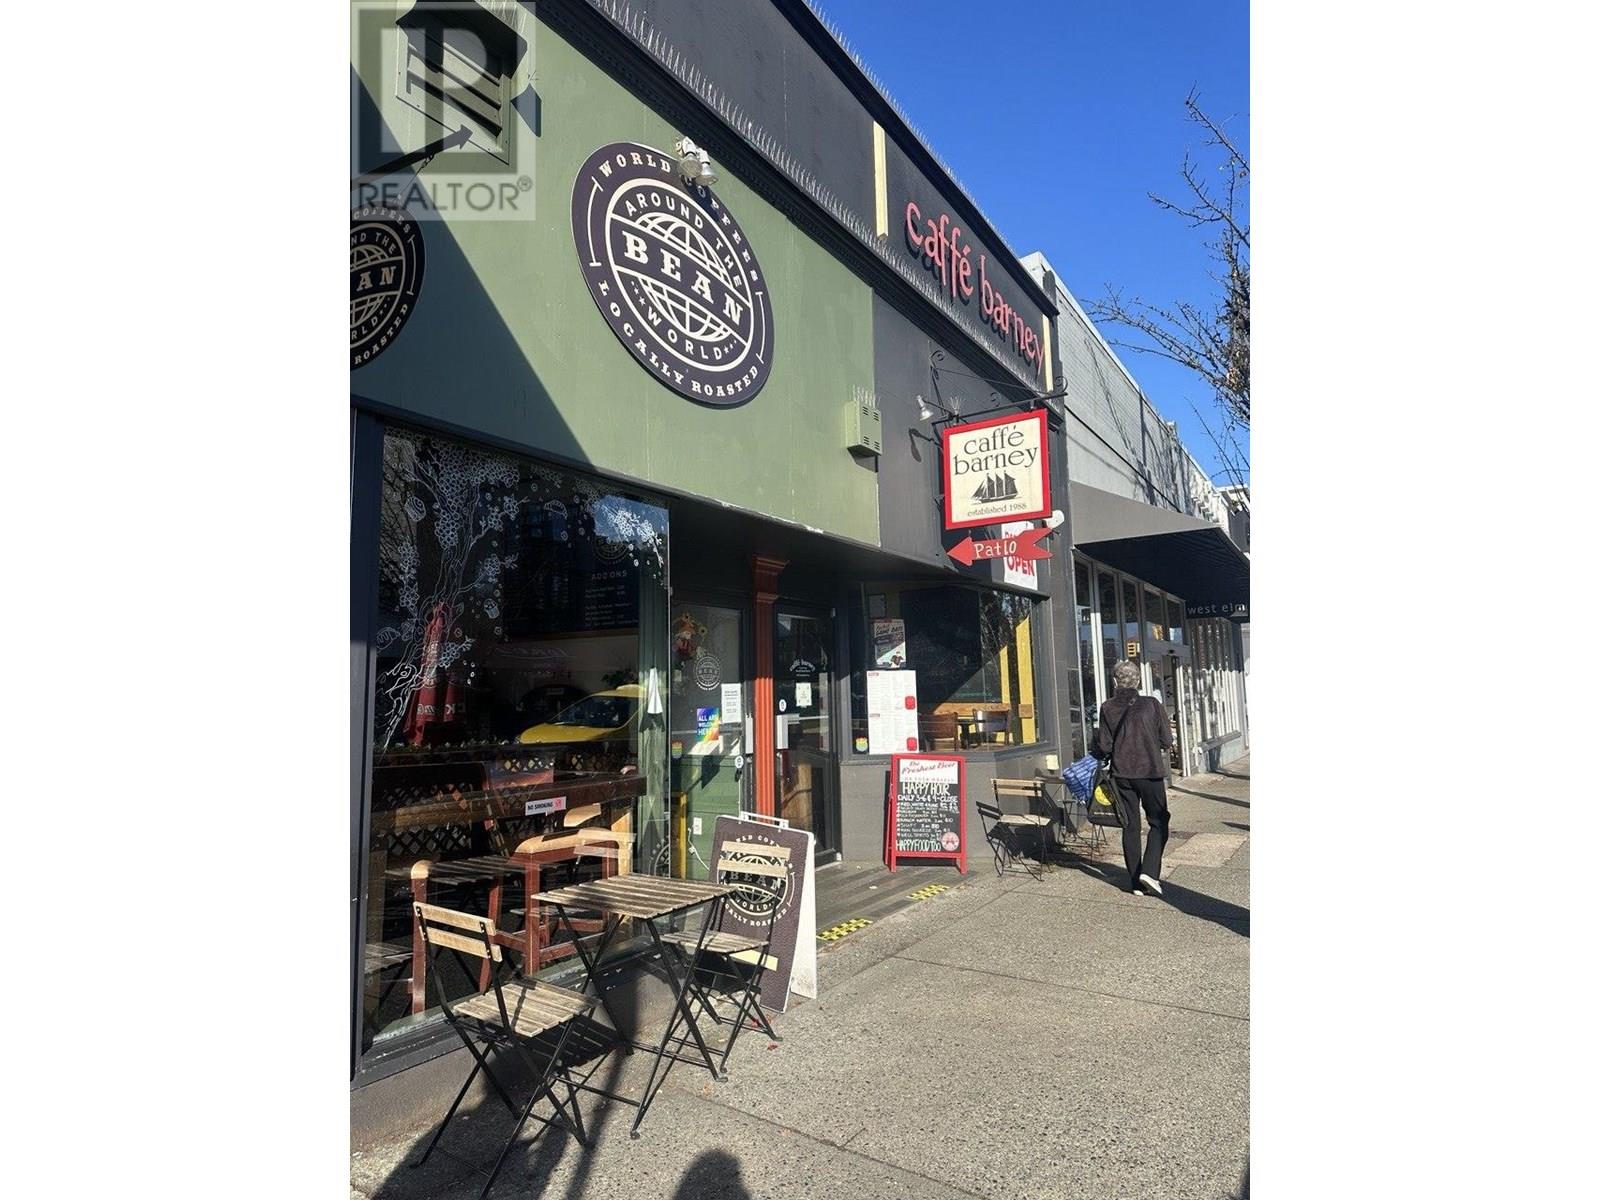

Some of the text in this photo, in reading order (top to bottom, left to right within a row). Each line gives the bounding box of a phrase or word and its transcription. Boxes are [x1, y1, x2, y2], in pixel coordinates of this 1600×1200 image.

[598, 151, 671, 178] WORLD
[375, 231, 396, 255] THE
[625, 192, 742, 289] AROUND THE
[356, 265, 397, 292] AN
[622, 230, 743, 327] BEAN
[906, 202, 1045, 375] caffé barney
[350, 315, 379, 341] RLD
[353, 303, 409, 365] ROASTED
[598, 279, 760, 398] LOCALLY ROASTED
[647, 307, 722, 361] WORLD
[963, 424, 1025, 456] caffé
[953, 446, 1039, 476] barney
[967, 503, 1007, 517] established
[1006, 554, 1035, 577] OPEN
[1187, 602, 1248, 615] west elm
[902, 782, 930, 796] HAPPY
[720, 896, 748, 924] OCALLY
